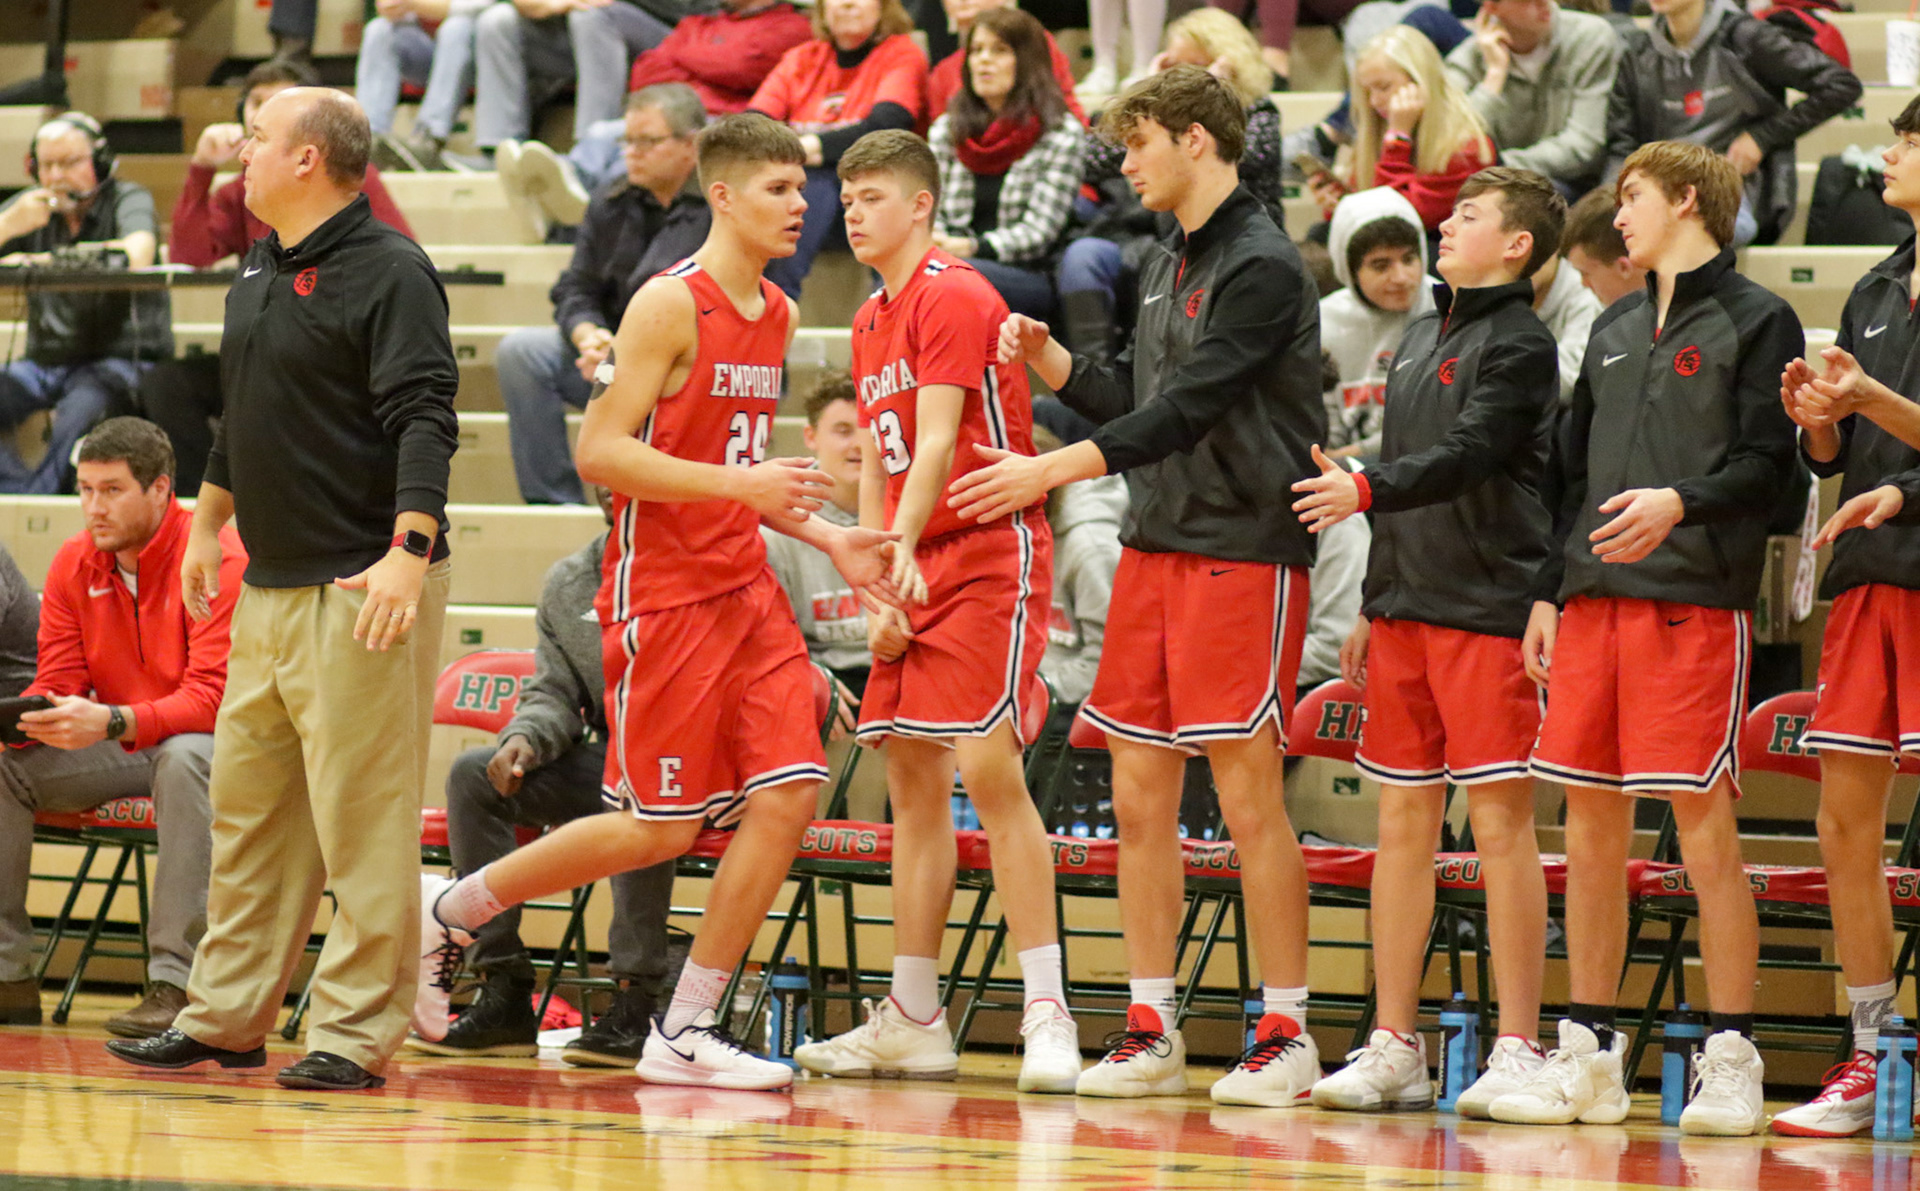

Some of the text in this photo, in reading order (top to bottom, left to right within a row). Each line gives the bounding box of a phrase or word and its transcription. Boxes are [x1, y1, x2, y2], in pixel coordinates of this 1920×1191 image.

[453, 674, 533, 712] HP
[1315, 701, 1363, 740] H
[1768, 714, 1818, 757] H
[659, 756, 683, 798] E
[96, 799, 158, 823] SCO
